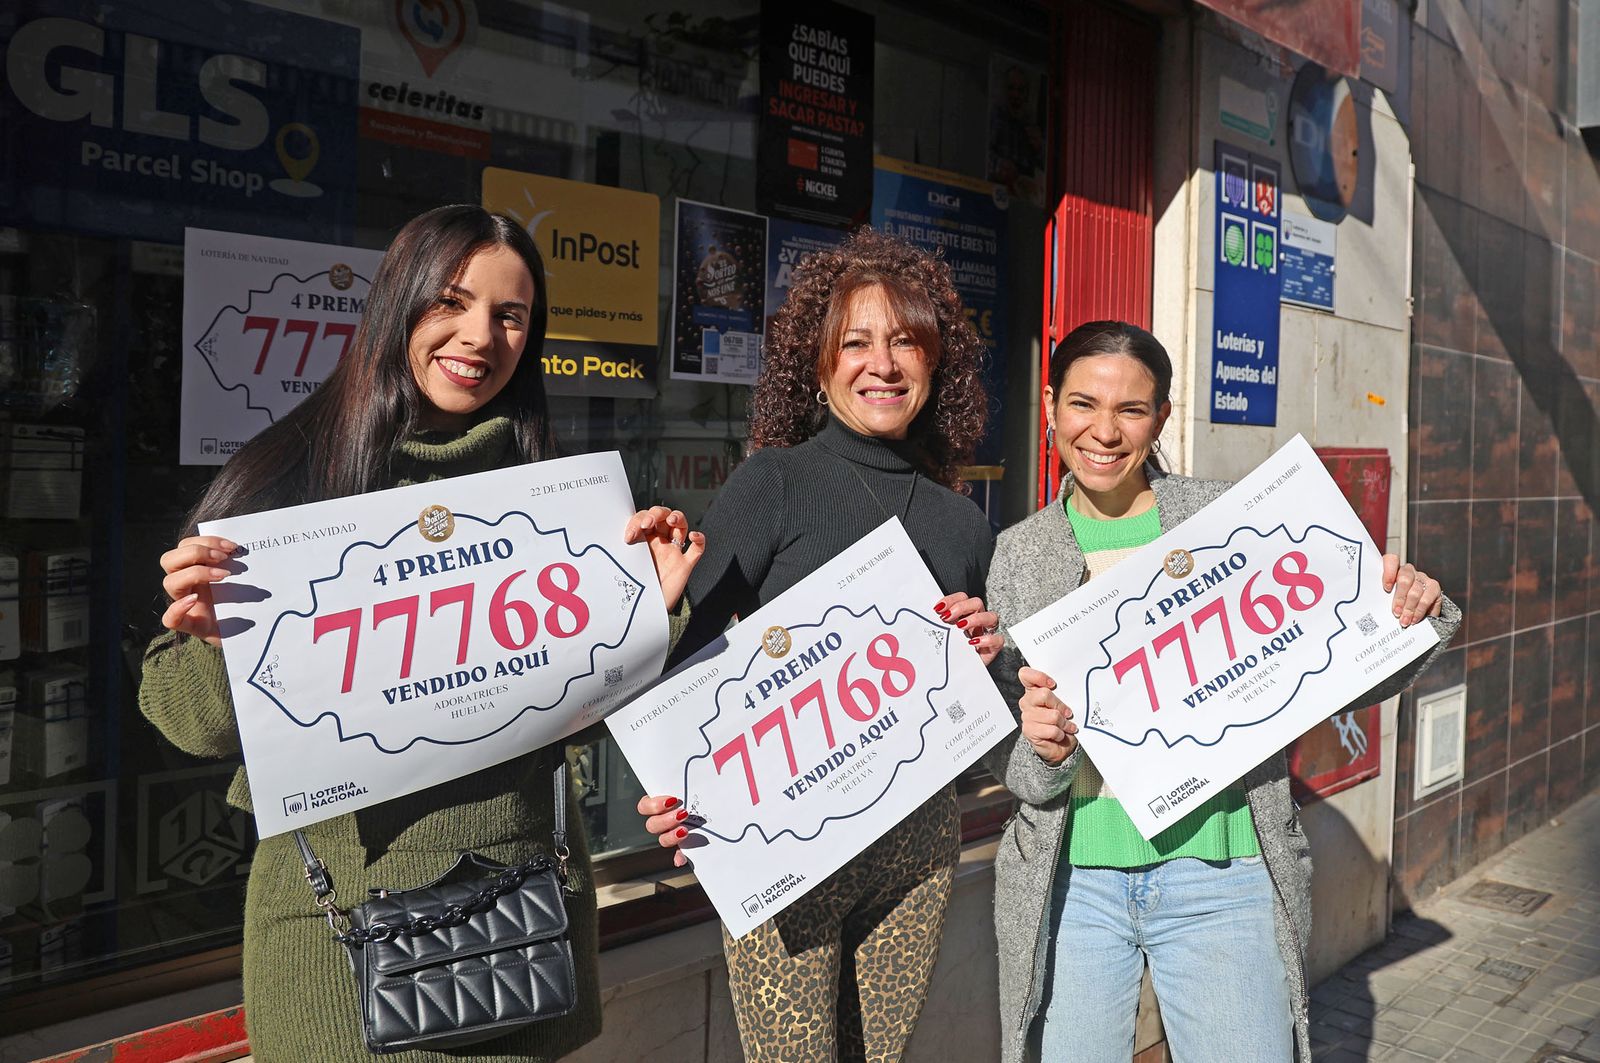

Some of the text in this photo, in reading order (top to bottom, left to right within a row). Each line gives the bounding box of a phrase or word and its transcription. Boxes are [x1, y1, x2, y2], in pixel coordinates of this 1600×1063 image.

[792, 24, 848, 55] ¿SABÍAS
[788, 42, 851, 76] QUE AQUÍ
[5, 16, 270, 151] GLS
[793, 64, 845, 93] PUEDES
[368, 82, 484, 120] celeritas
[778, 80, 857, 115] INGRESAR Y
[769, 96, 815, 126] SACAR
[817, 112, 865, 137] PASTA?
[81, 141, 264, 197] Parcel Shop
[928, 191, 960, 207] DIGI
[200, 249, 236, 260] LOTERÍA
[251, 254, 289, 266] NAVIDAD
[552, 229, 639, 269] InPost
[551, 305, 643, 321] que pides y más
[1217, 330, 1264, 359] Loterías y
[584, 356, 645, 379] Pack
[1216, 361, 1276, 385] Apuestas del
[1215, 391, 1248, 411] Estado
[530, 474, 611, 497] 22 DE DICIEMBRE
[1243, 463, 1303, 512] 22 DE DICIEMBRE
[283, 532, 299, 545] DE
[302, 522, 357, 541] NAVIDAD
[395, 538, 514, 581] PREMIO
[837, 545, 895, 590] 22 DE DICIEMBRE
[1156, 552, 1247, 617] PREMIO
[313, 562, 590, 693] 77768
[1032, 588, 1120, 646] LOTERÍA DE NAVIDAD
[1113, 551, 1324, 712] 77768
[1355, 627, 1404, 662] COMPARTIRL
[382, 645, 550, 706] VENDIDO AQUÍ
[755, 632, 842, 700] PREMIO
[1182, 619, 1305, 709] VENDIDO AQUÍ
[1226, 661, 1281, 702] ADORATRICES
[433, 683, 509, 711] ADORATRICES
[629, 702, 668, 732] LOTERÍA
[668, 694, 681, 707] DE
[681, 667, 719, 697] NAVIDAD
[1243, 678, 1276, 704] HUELVA
[450, 703, 496, 720] HUELVA
[712, 633, 916, 806] 77768
[944, 711, 991, 750] COMPARTIRLO
[783, 707, 900, 801] VENDIDO AQUÍ
[826, 751, 878, 792] ADORATRICES
[310, 782, 356, 800] LOTERÍA
[311, 787, 368, 809] NACIONAL
[841, 768, 874, 794] HUELVA
[1166, 776, 1198, 802] LOTERÍA
[1171, 778, 1210, 807] NACIONAL
[761, 872, 795, 899] LOTERÍA
[765, 874, 806, 906] NACIONAL
